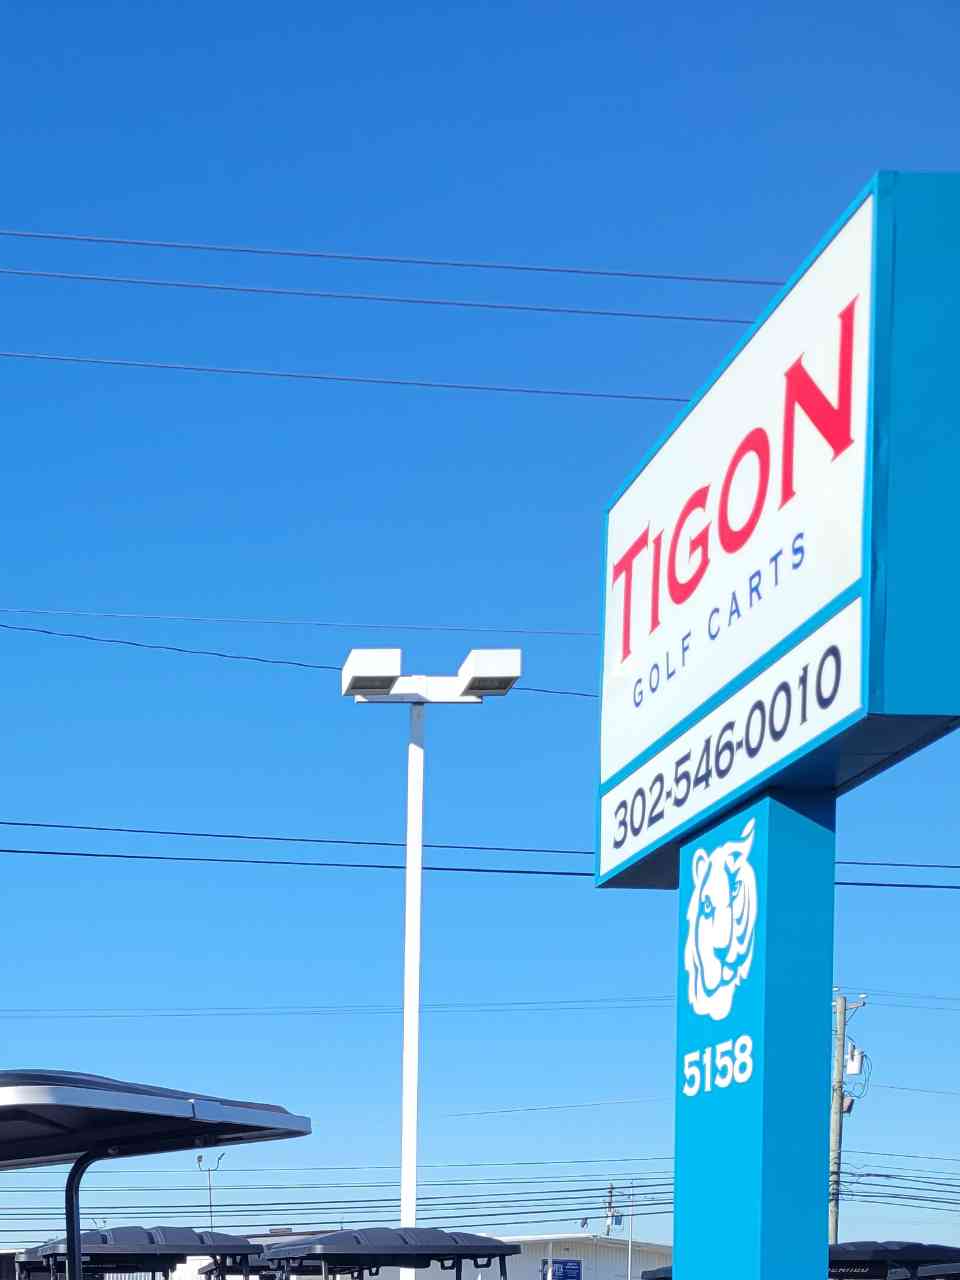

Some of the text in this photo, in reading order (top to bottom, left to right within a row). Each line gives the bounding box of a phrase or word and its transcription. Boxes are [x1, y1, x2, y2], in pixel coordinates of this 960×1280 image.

[611, 294, 859, 664] TIGON
[632, 531, 807, 709] GOLF CARTS
[612, 643, 843, 850] 302-546-0010
[682, 1034, 754, 1097] 5158
